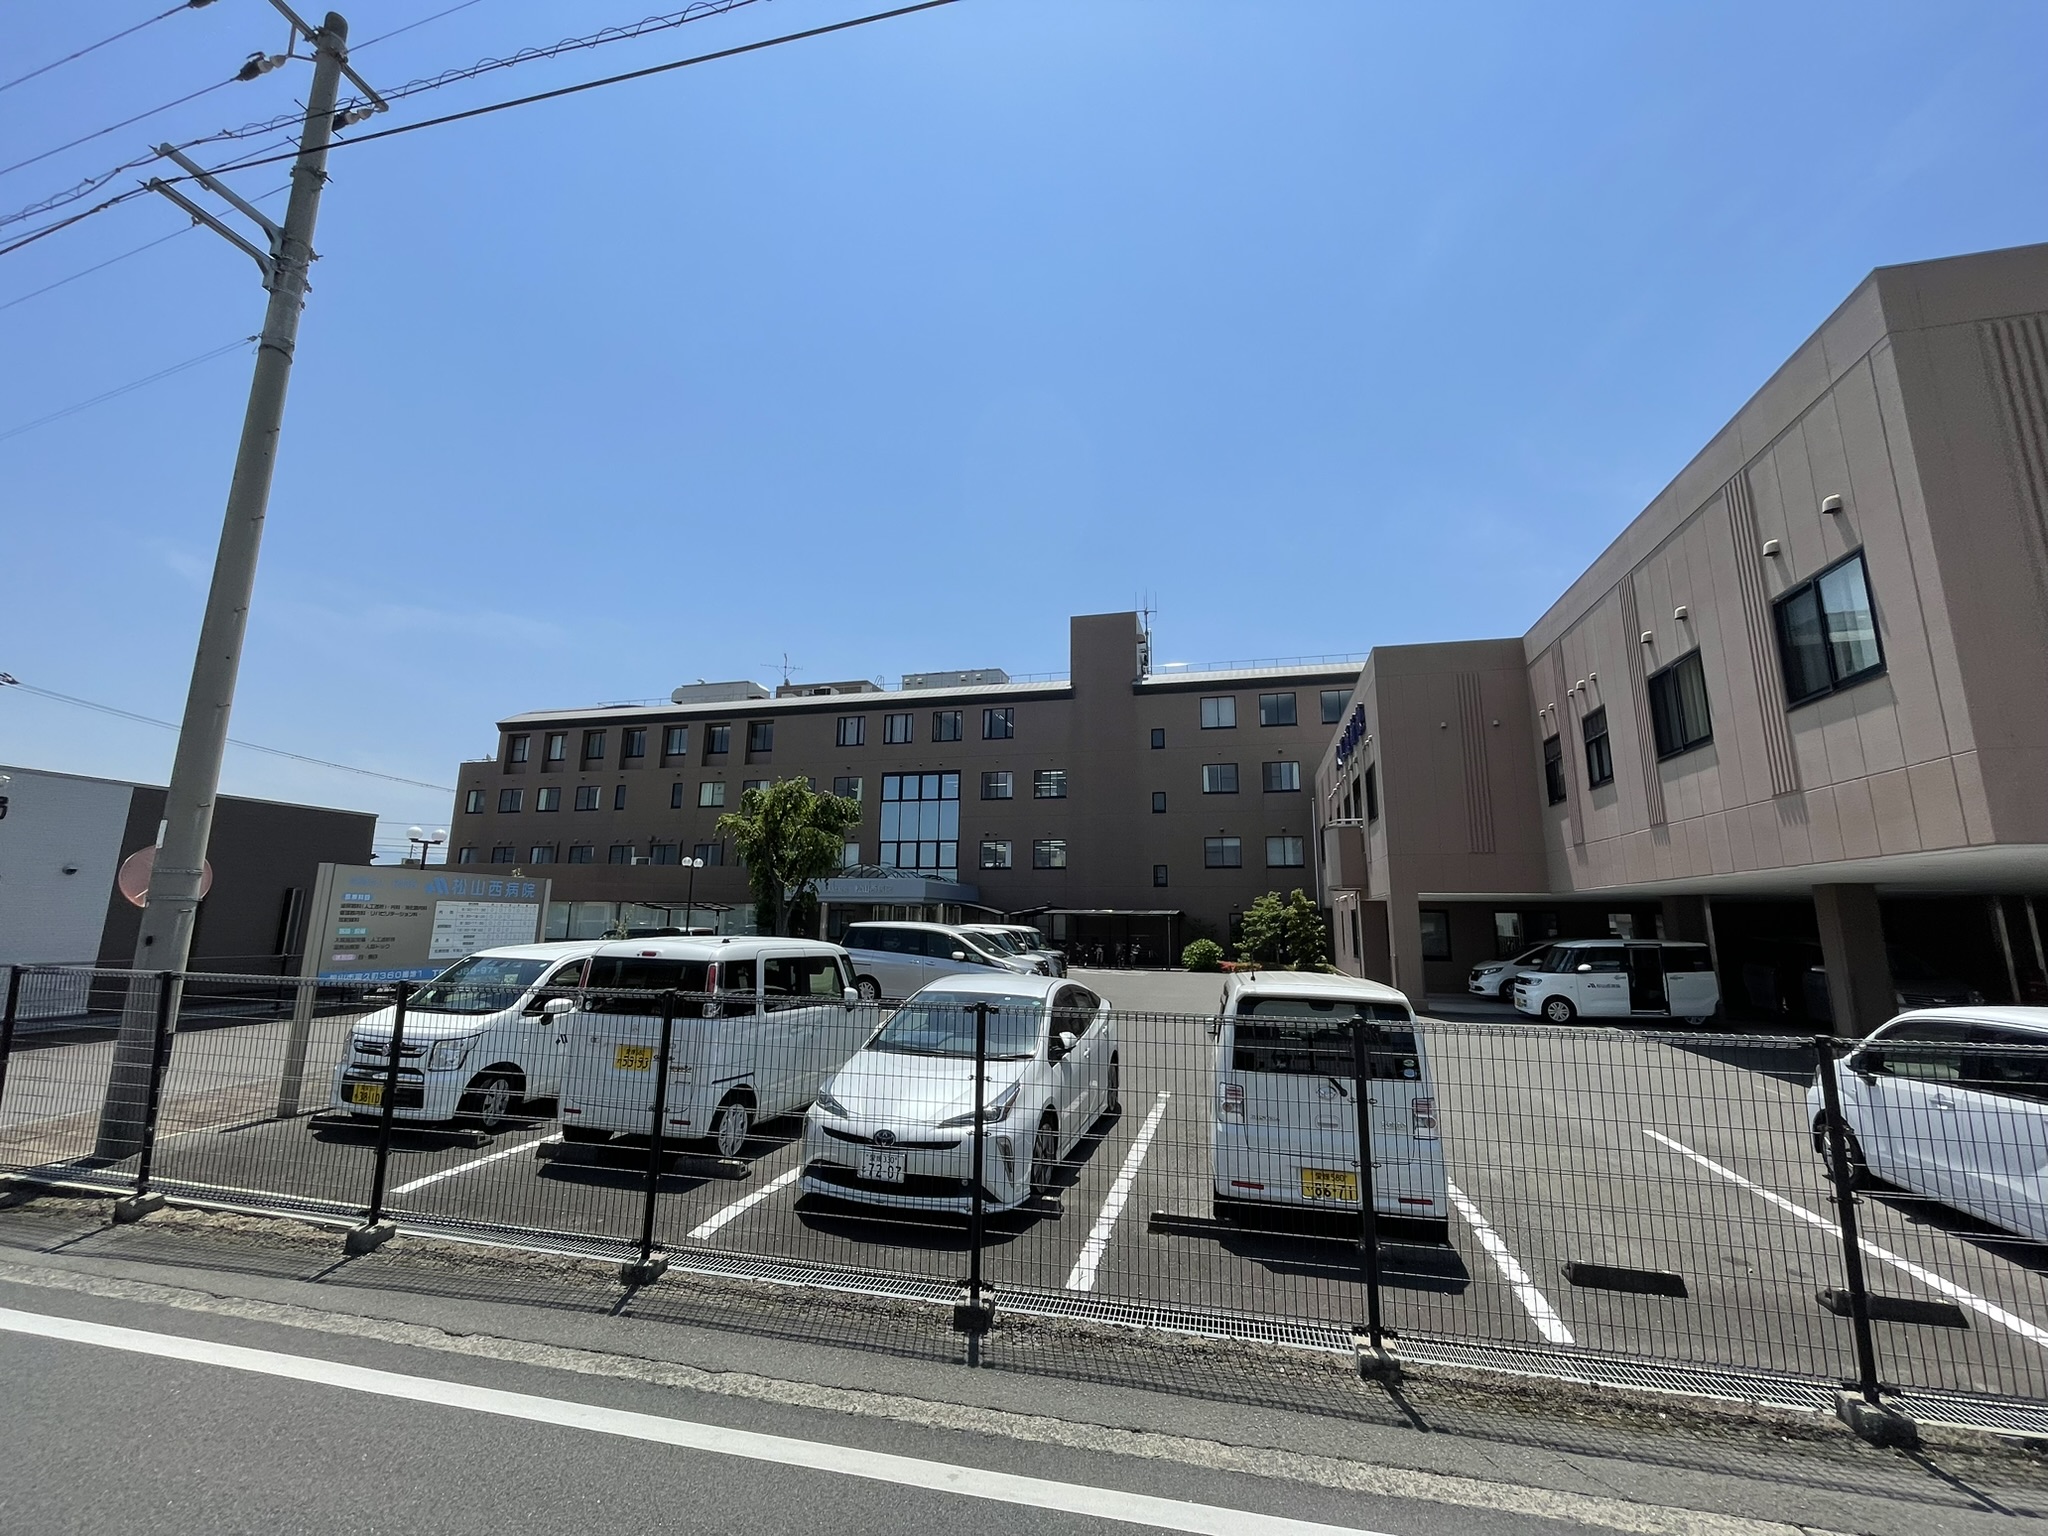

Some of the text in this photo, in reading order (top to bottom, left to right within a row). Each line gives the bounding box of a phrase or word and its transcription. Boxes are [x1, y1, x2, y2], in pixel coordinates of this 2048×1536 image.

[452, 878, 536, 899] 松山西病院
